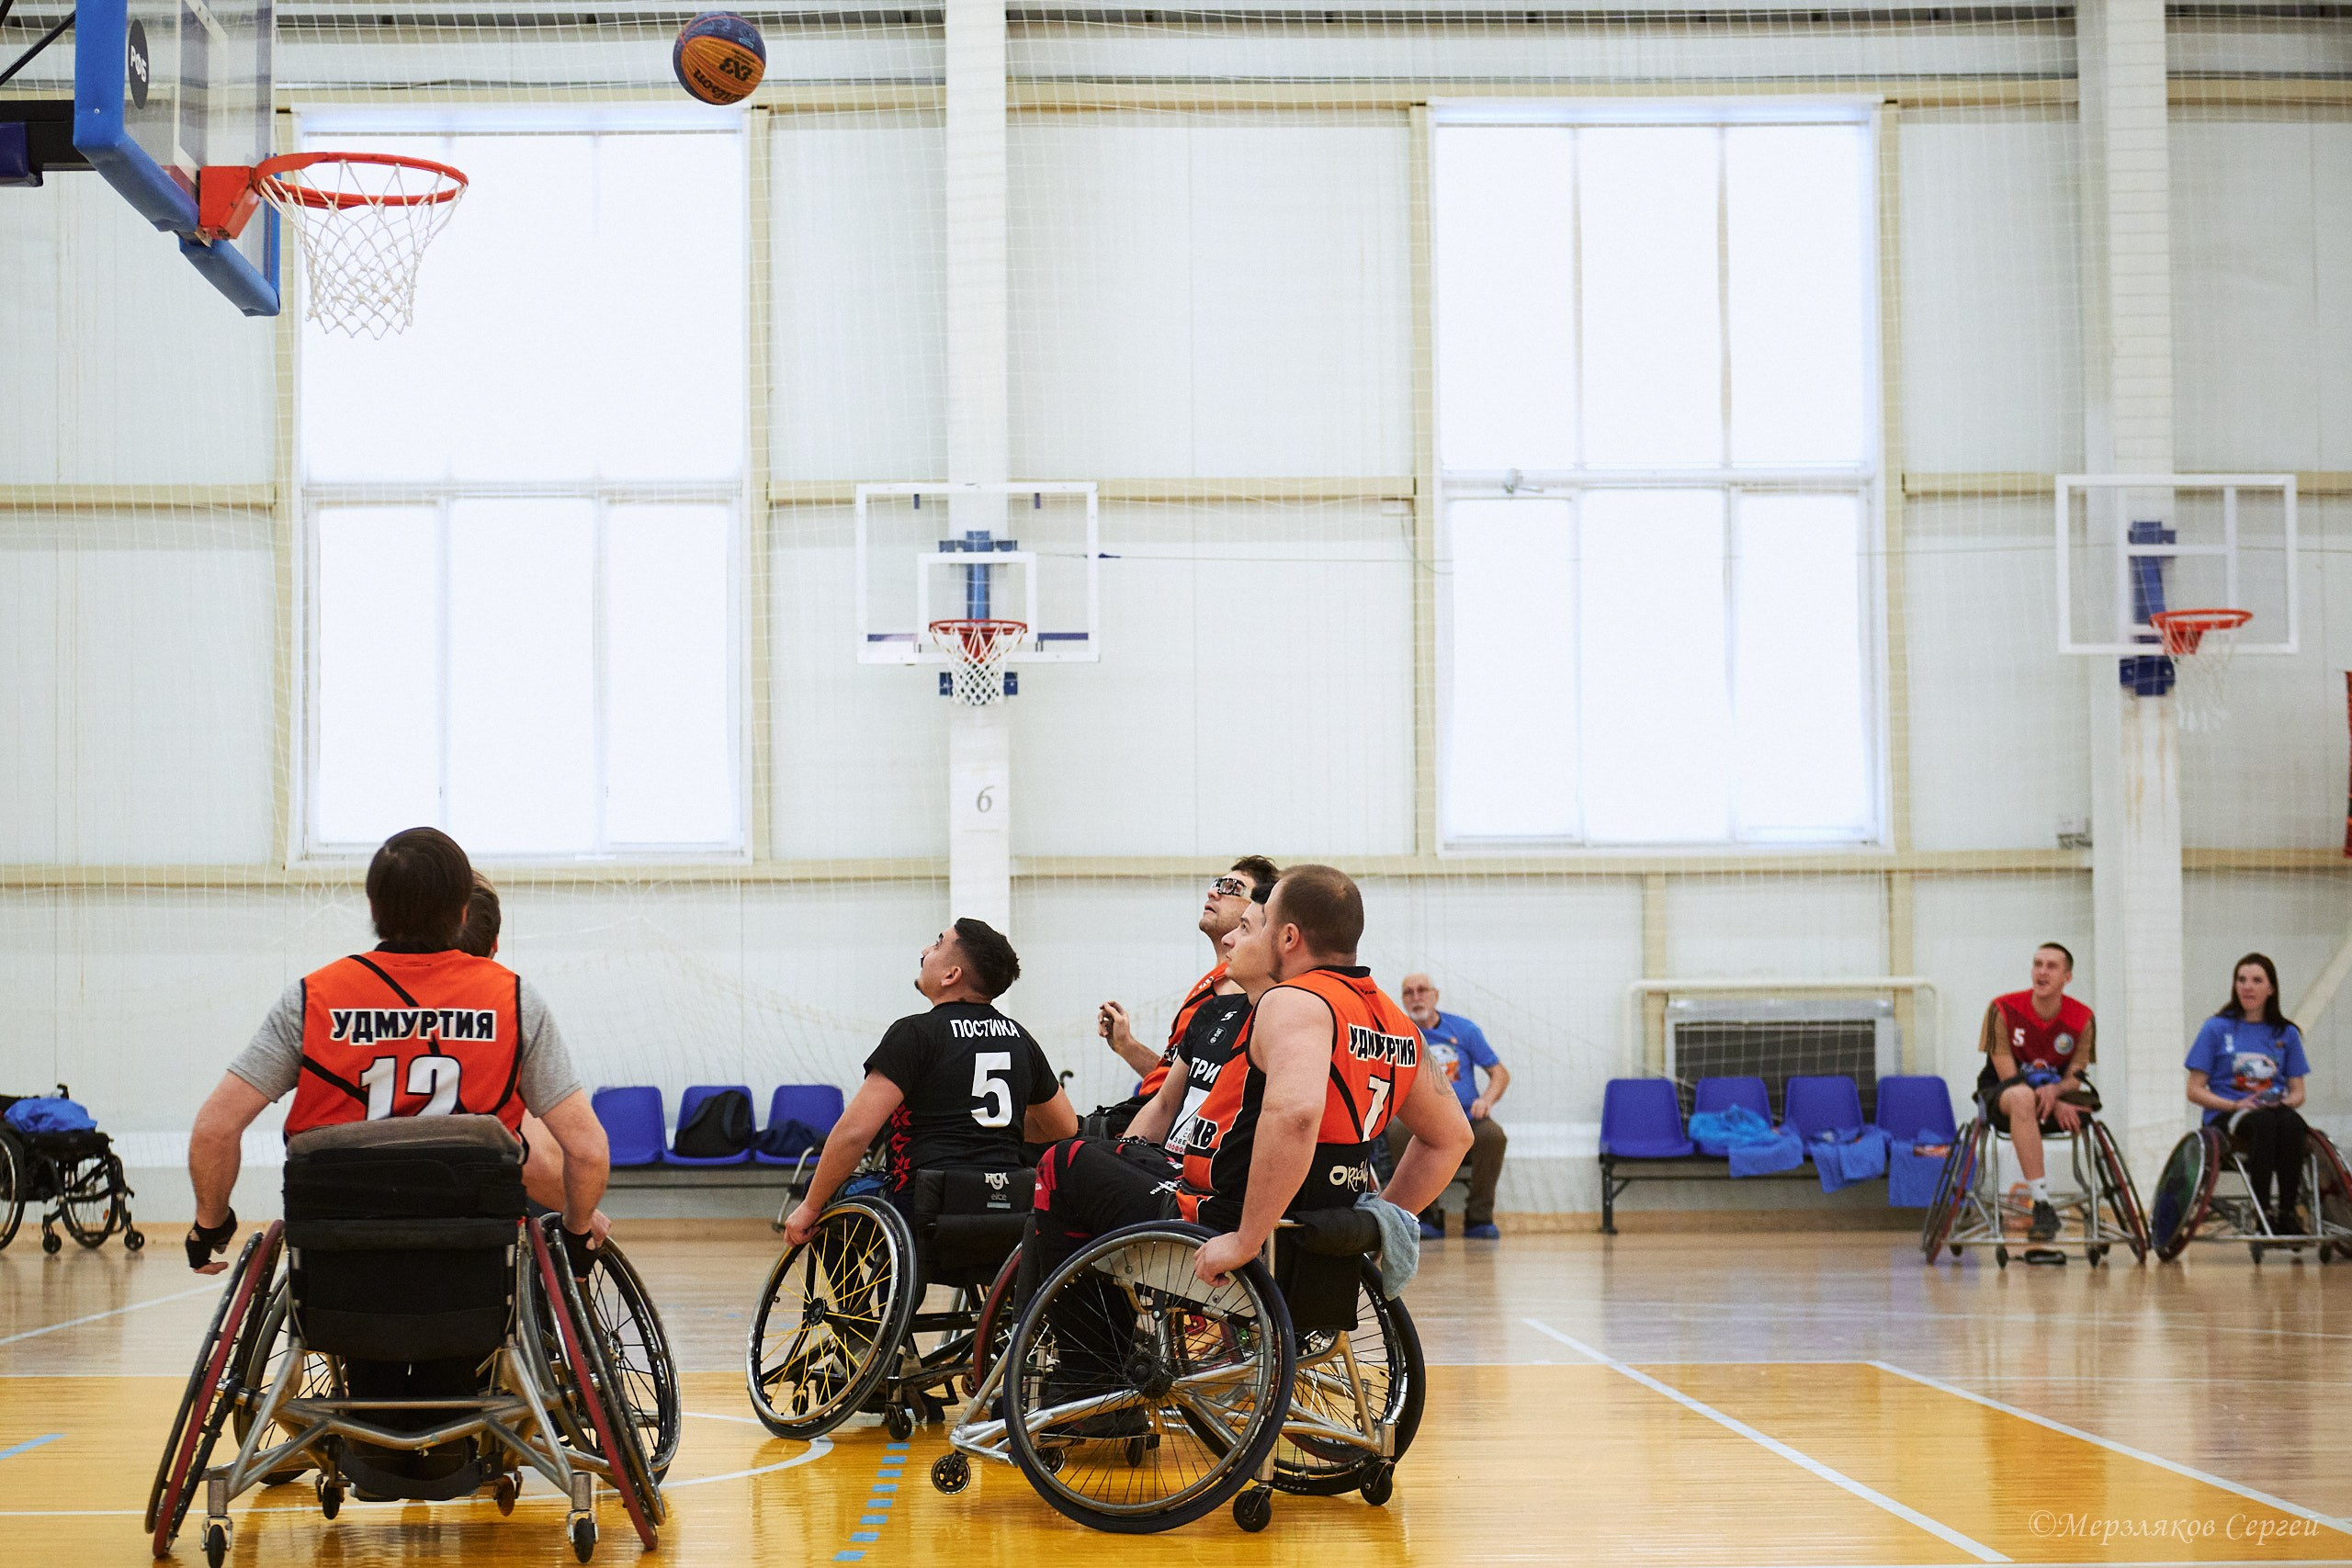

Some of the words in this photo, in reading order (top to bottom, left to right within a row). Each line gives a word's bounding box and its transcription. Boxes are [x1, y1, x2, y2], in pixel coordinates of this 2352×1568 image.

[130, 44, 147, 83] РФБ
[977, 784, 995, 813] 6
[329, 1009, 497, 1046] УДМУРТИЯ
[949, 1018, 1021, 1038] ПОСТИКА
[1348, 1022, 1417, 1067] УДМУРТИЯ
[2012, 1028, 2026, 1046] 5
[359, 1055, 462, 1121] 12
[970, 1051, 1012, 1128] 5
[1367, 1075, 1391, 1143] 7
